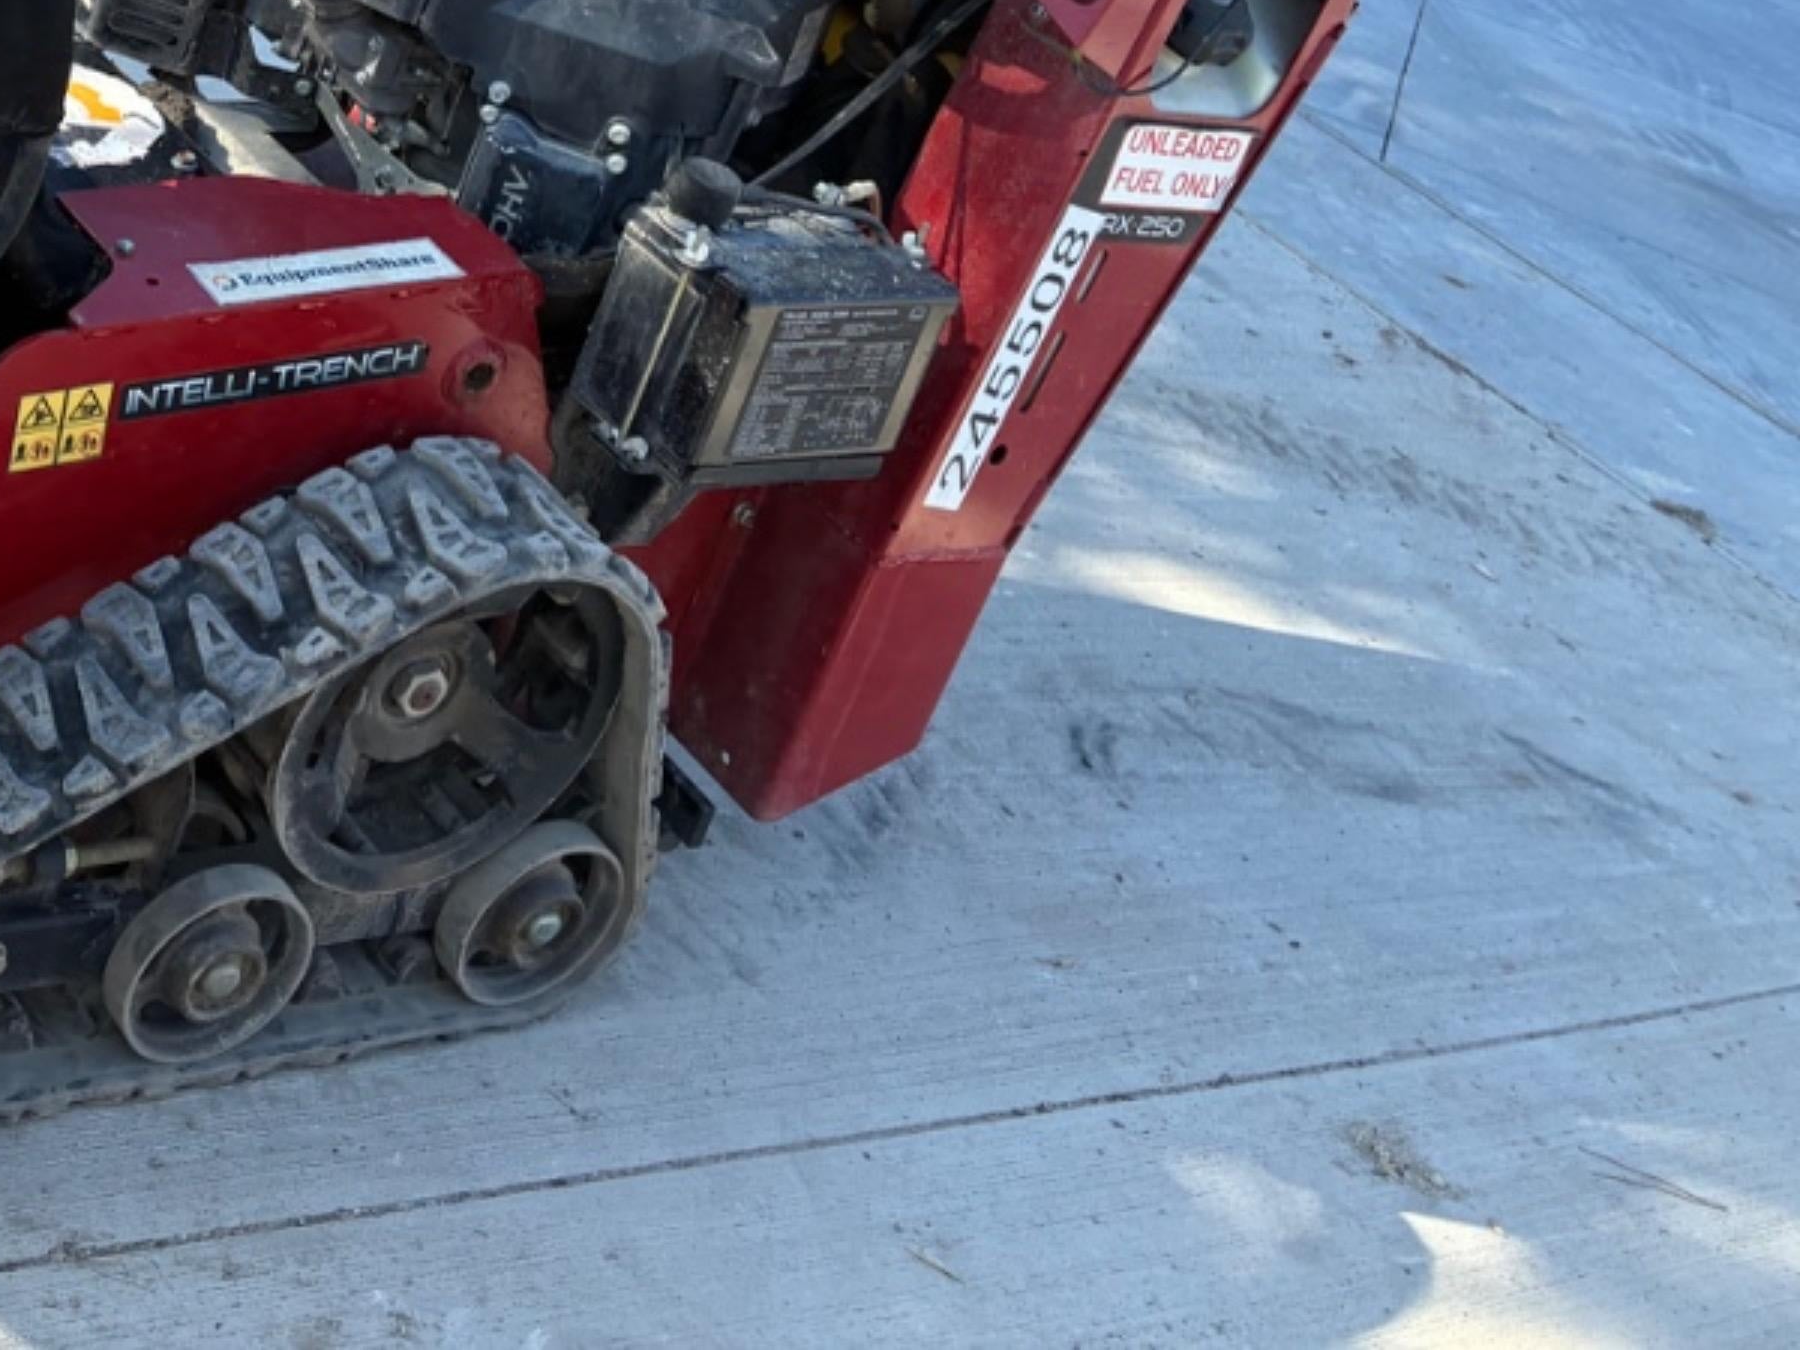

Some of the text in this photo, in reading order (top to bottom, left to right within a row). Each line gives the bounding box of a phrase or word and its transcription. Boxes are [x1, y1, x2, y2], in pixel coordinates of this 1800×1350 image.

[1128, 127, 1242, 163] UNLEADED
[1113, 166, 1164, 195] FUEL
[238, 253, 437, 287] EquipmentShare
[938, 226, 1089, 494] 245508
[124, 344, 419, 415] INTELLI-TRENCH
